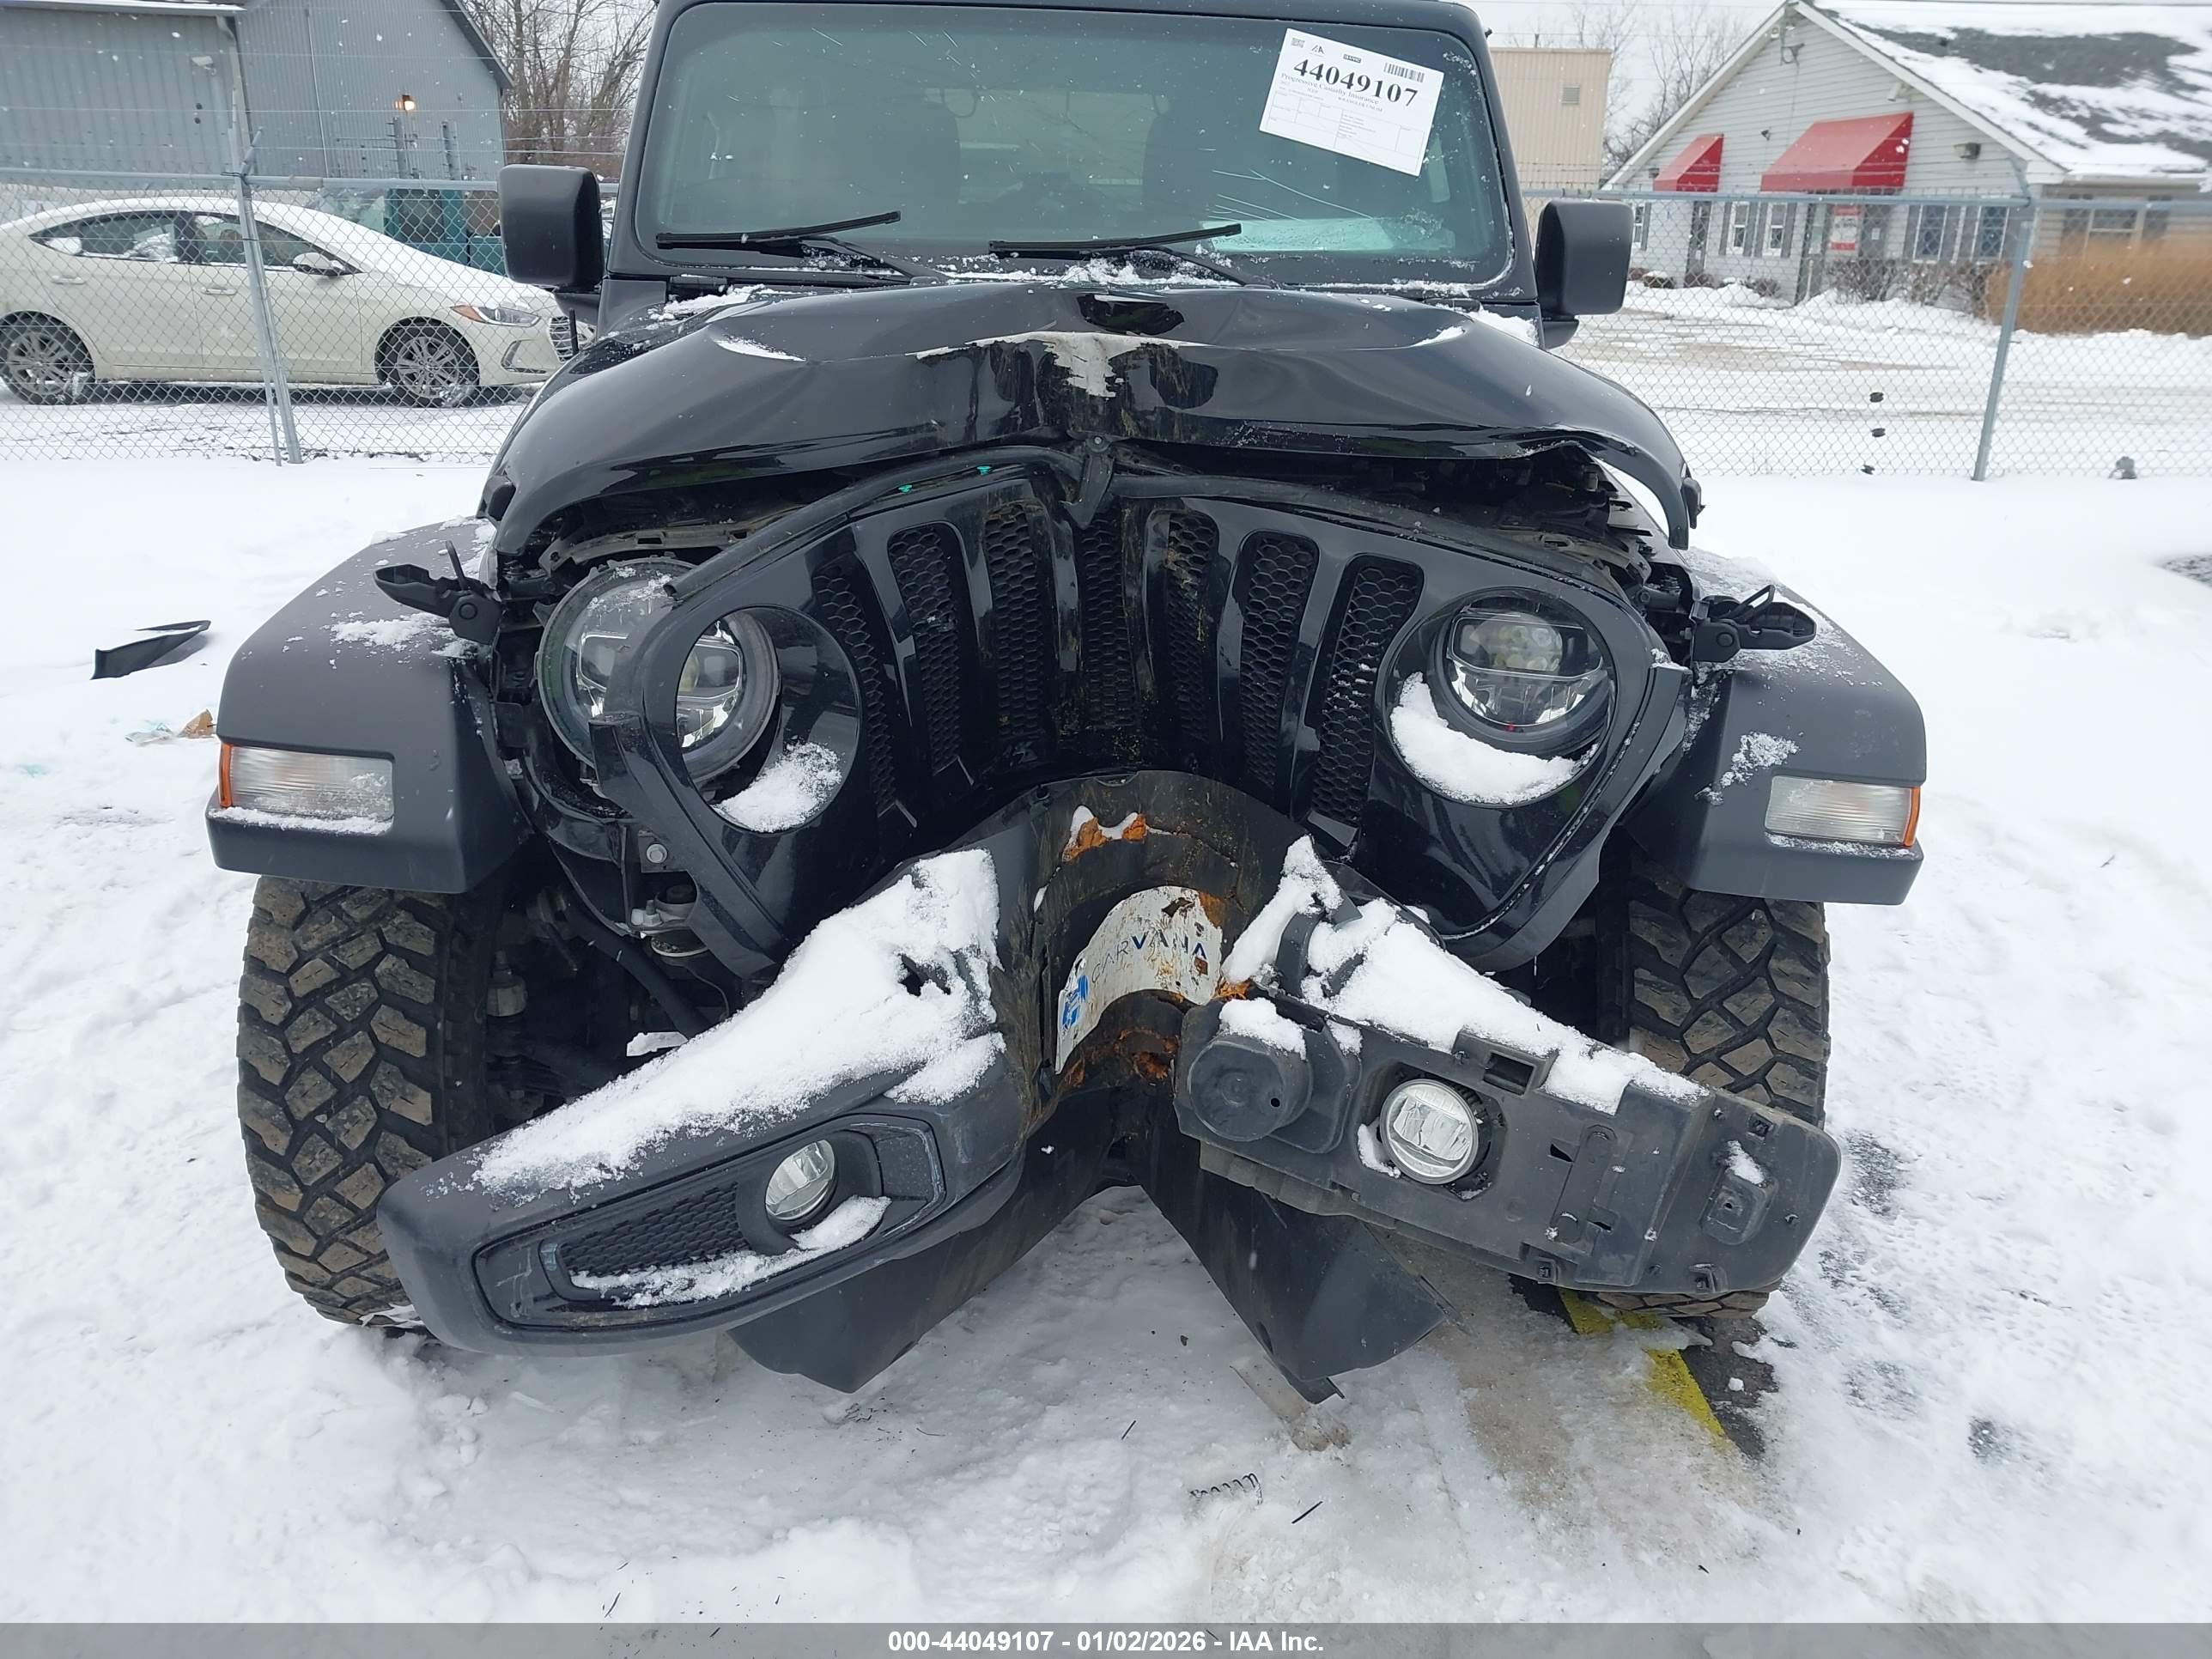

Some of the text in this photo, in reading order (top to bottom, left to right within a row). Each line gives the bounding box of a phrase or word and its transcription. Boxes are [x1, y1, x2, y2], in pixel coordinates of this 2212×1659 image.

[1281, 73, 1318, 88] Progressive
[1319, 83, 1346, 96] Casualty
[1348, 88, 1379, 105] Insurance
[1293, 58, 1419, 106] 44049107
